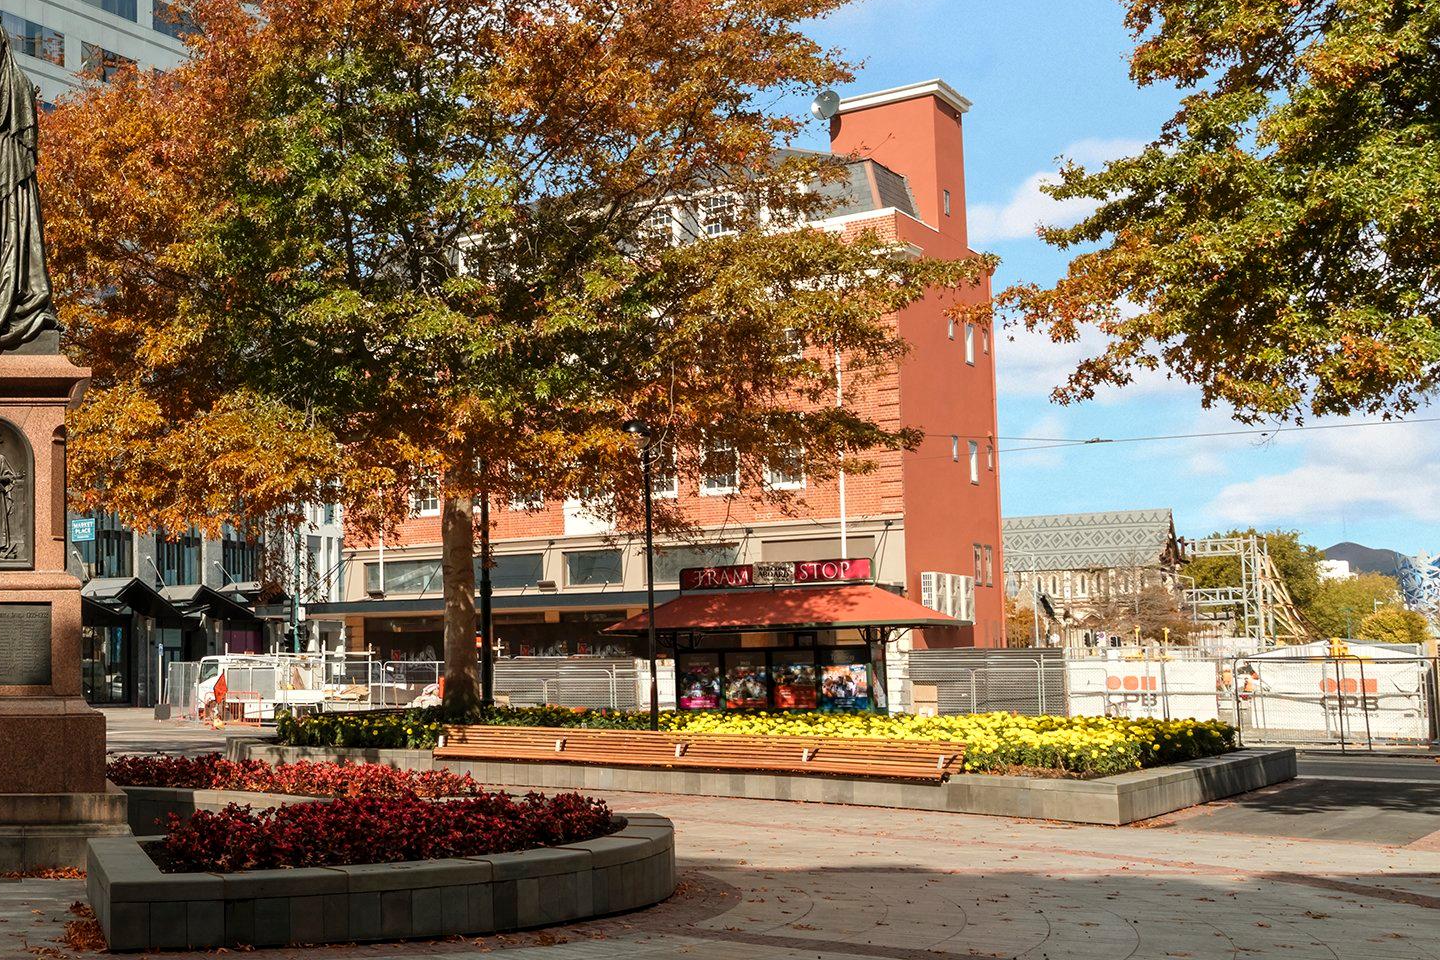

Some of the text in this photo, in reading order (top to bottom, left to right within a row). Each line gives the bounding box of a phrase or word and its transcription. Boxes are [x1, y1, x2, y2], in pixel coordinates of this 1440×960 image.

[694, 560, 850, 585] TRAM STOP
[757, 570, 790, 578] ABOARD
[1320, 695, 1379, 711] CPB
